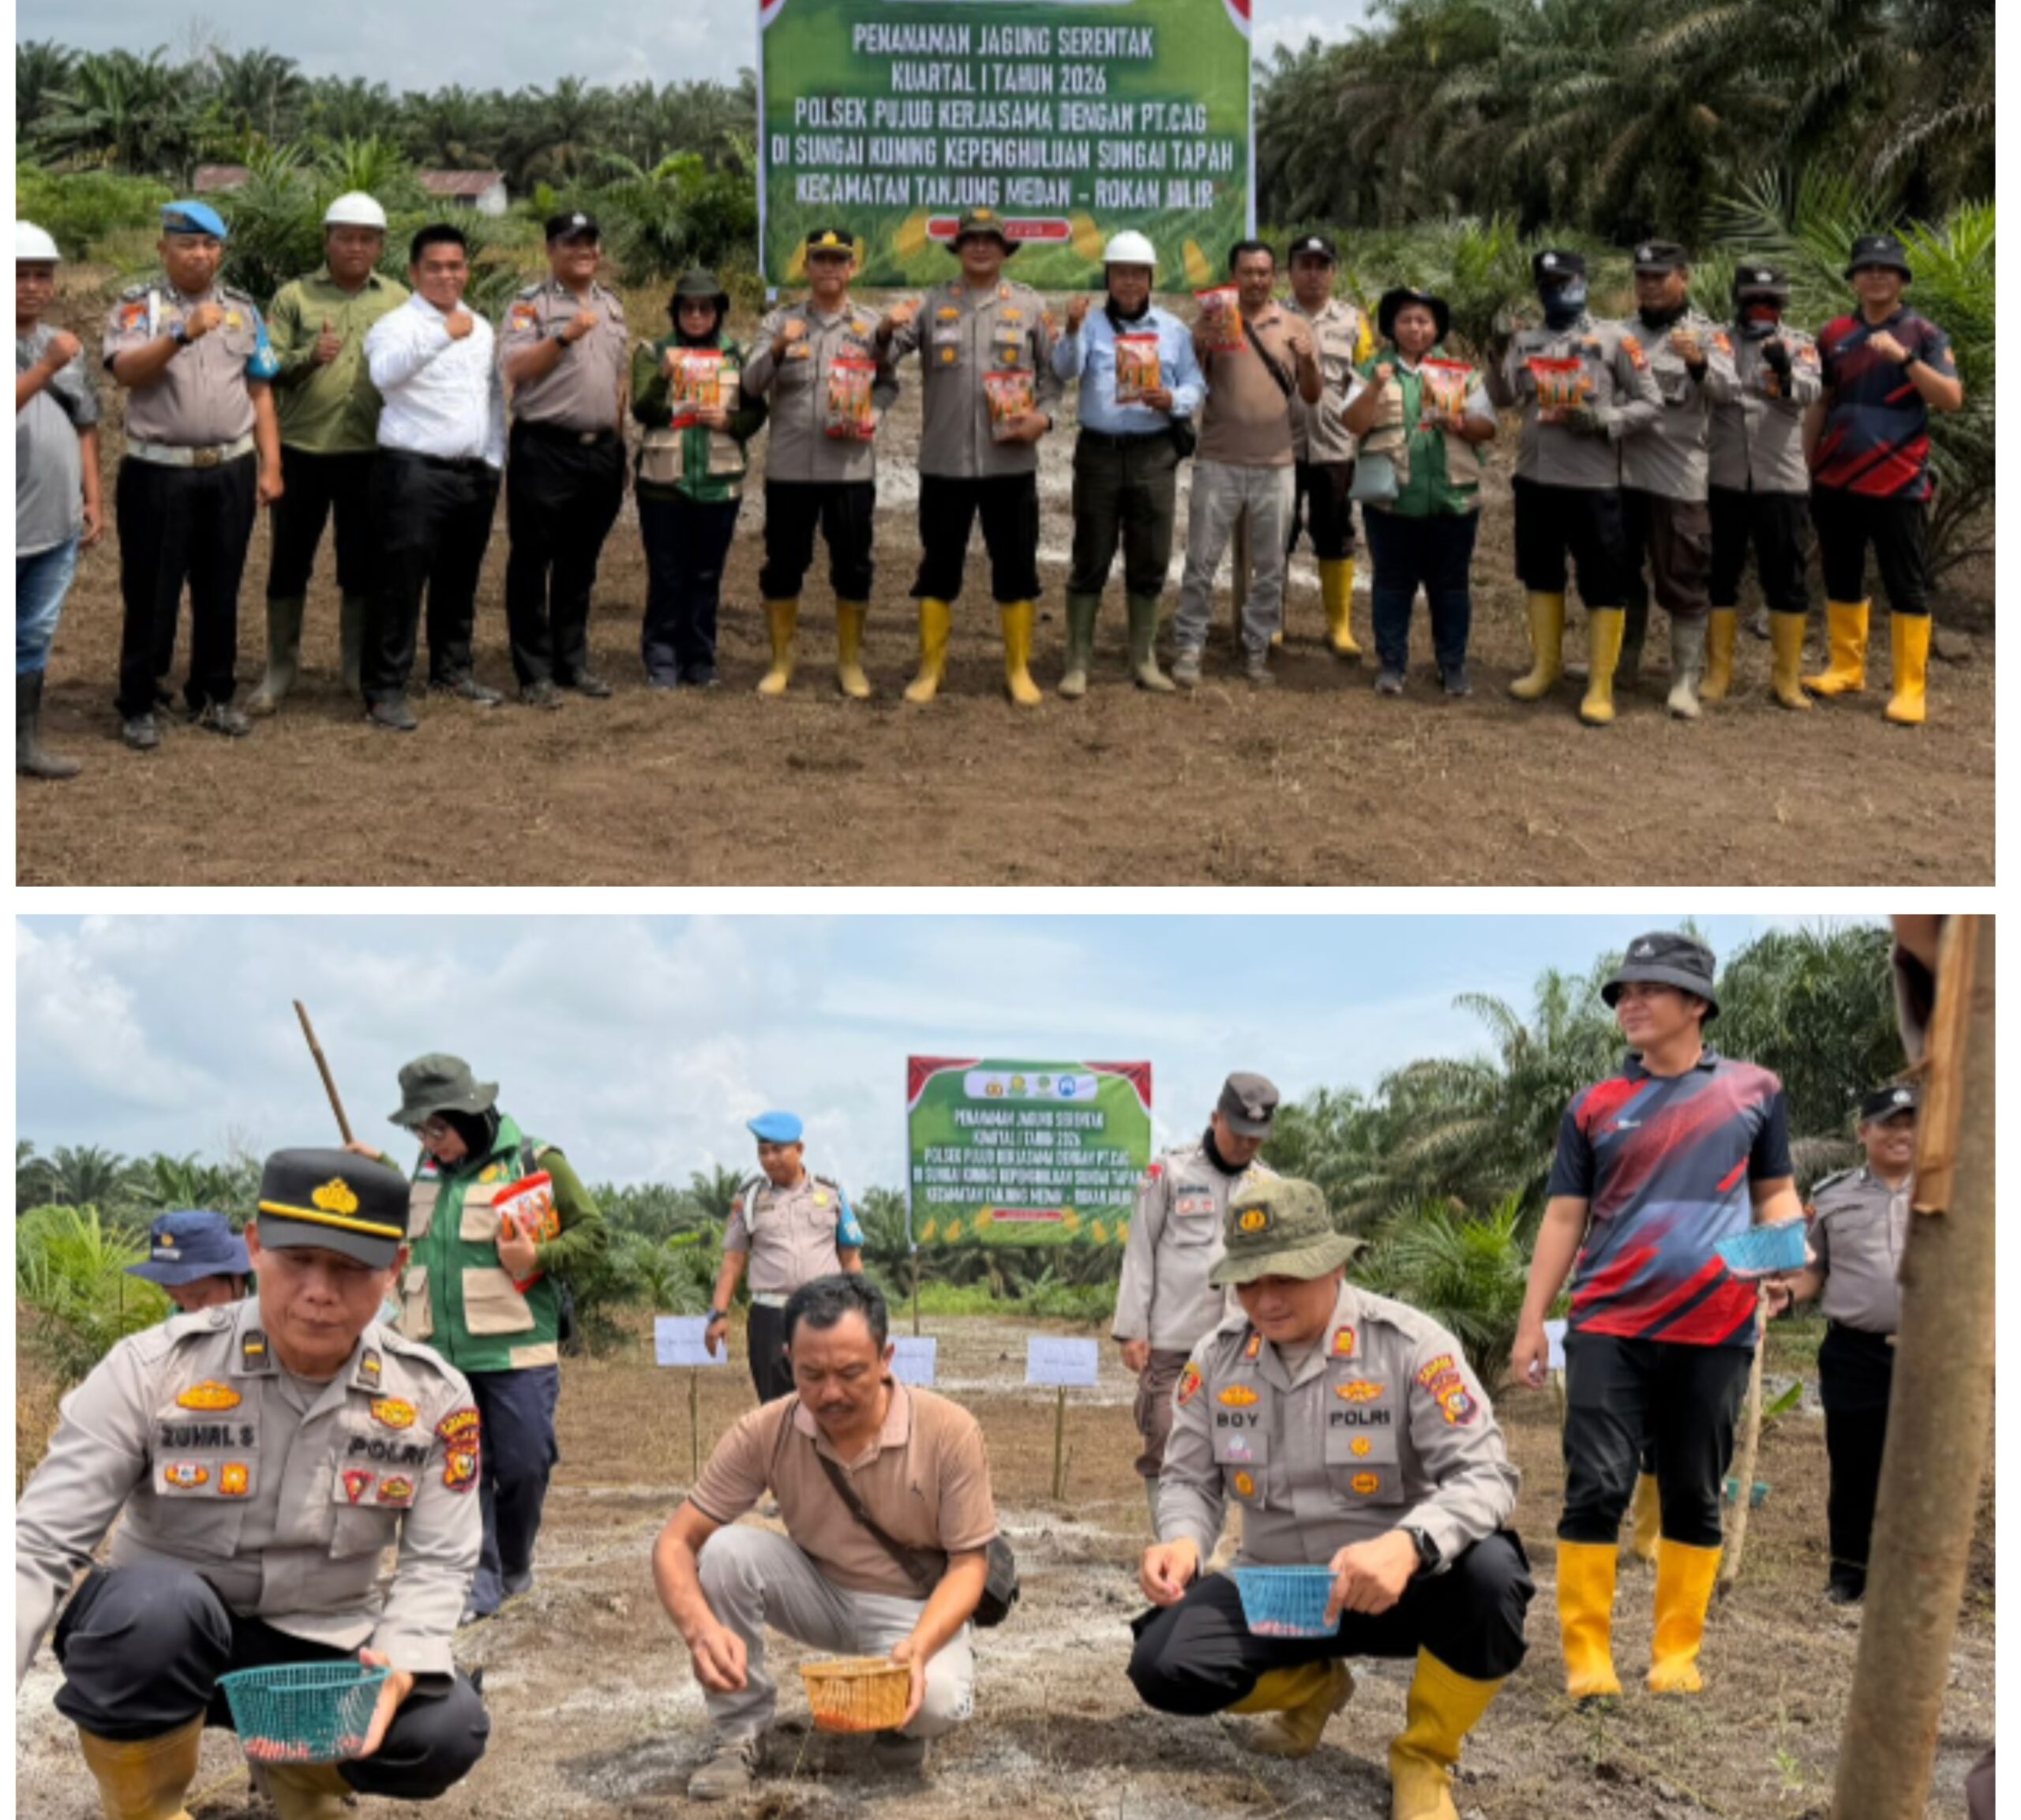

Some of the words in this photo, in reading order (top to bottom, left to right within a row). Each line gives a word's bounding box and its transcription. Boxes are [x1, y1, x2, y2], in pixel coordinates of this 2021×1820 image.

[853, 24, 970, 54] PENANAMAN
[978, 24, 1050, 55] JAGUNG
[1058, 26, 1153, 58] SERENTAK
[891, 61, 975, 92] KUARTAL
[992, 63, 1053, 94] TAHUN
[1059, 64, 1107, 94] 2026
[795, 96, 867, 128] POLSEK
[874, 98, 934, 129] PUJUD
[938, 99, 1053, 130] KERJASAMA
[1059, 102, 1134, 132] DENGAN
[1142, 103, 1207, 134] PT.CAG
[771, 133, 789, 165] DI
[796, 135, 864, 166] SUNGAI
[945, 137, 1090, 169] KEPENGHULUAN
[1098, 139, 1166, 170] SUNGAI
[1172, 141, 1233, 171] TAPAH
[796, 173, 909, 205] KECAMATAN
[915, 175, 1000, 205] TANJUNG
[1005, 176, 1070, 207] MEDAN
[1095, 178, 1160, 208] ROKAN
[1217, 1412, 1259, 1428] BOY
[1330, 1409, 1391, 1426] POLRI
[348, 1435, 430, 1465] POLRI
